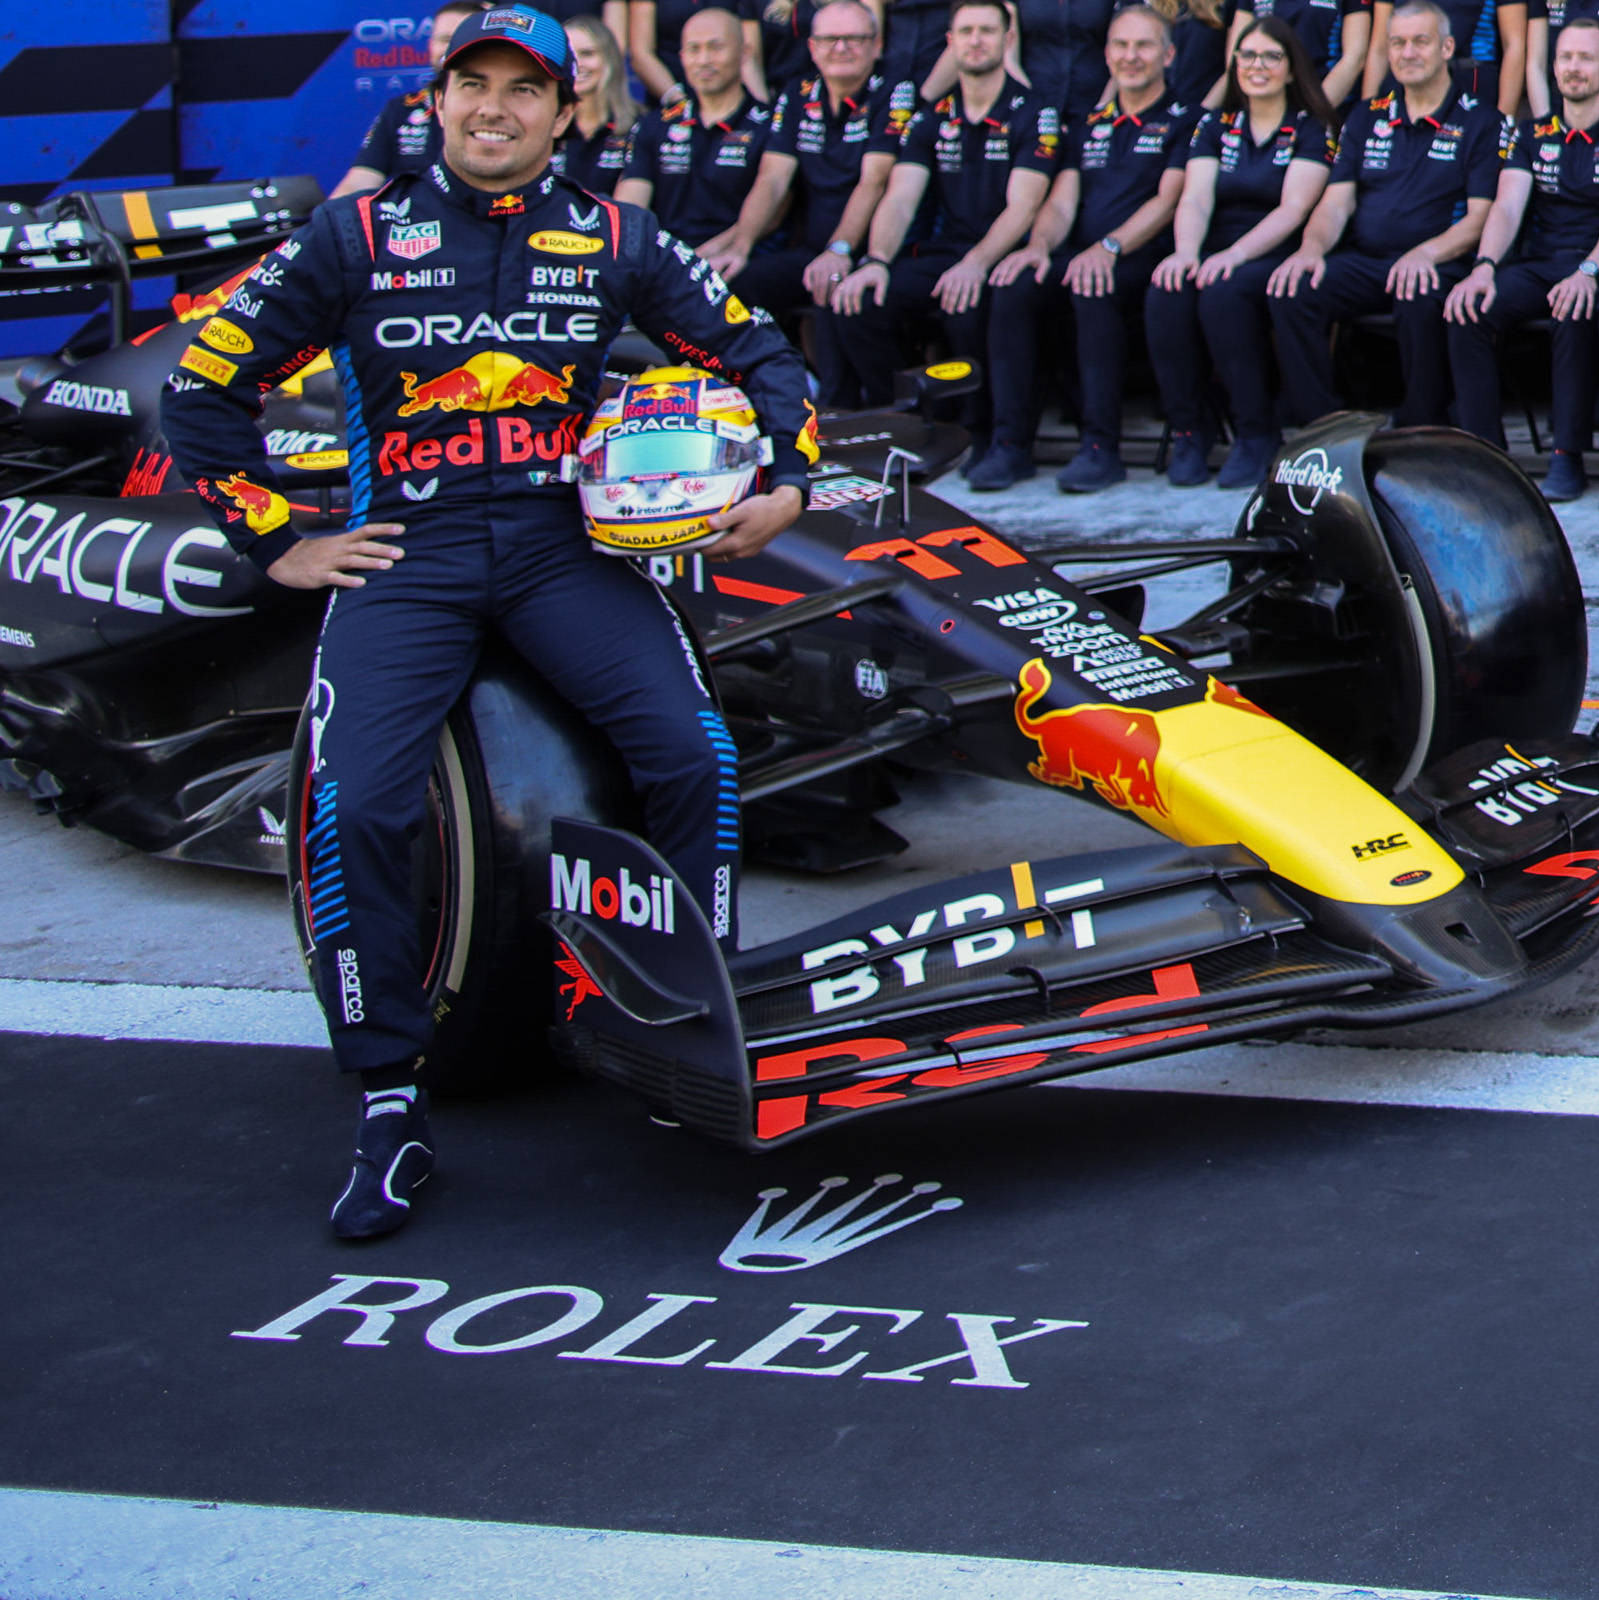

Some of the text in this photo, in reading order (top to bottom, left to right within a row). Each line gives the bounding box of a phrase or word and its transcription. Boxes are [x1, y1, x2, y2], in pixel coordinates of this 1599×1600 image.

[354, 18, 433, 43] ORA
[393, 226, 438, 240] TAG
[371, 268, 432, 290] Mobil
[530, 265, 600, 288] BYBIT
[526, 292, 602, 307] HONDA
[375, 311, 601, 348] ORACLE
[43, 379, 132, 417] HONDA
[623, 398, 696, 419] Red Bull
[606, 417, 713, 441] ORACLE
[378, 417, 484, 476] Red
[1275, 458, 1312, 487] Hard
[608, 522, 706, 548] GUADALAJARA
[0, 495, 255, 618] RACLE
[971, 587, 1063, 613] VISA
[998, 605, 1060, 628] CDW
[0, 627, 36, 649] EMENS
[857, 668, 888, 691] FIA
[1108, 679, 1173, 702] Mobil
[1350, 832, 1409, 859] HRC
[550, 852, 676, 935] Mobil
[714, 863, 731, 939] sparco
[801, 860, 1105, 1015] BYBIT
[337, 948, 365, 1024] sparco
[229, 1272, 1089, 1389] ROLEX
